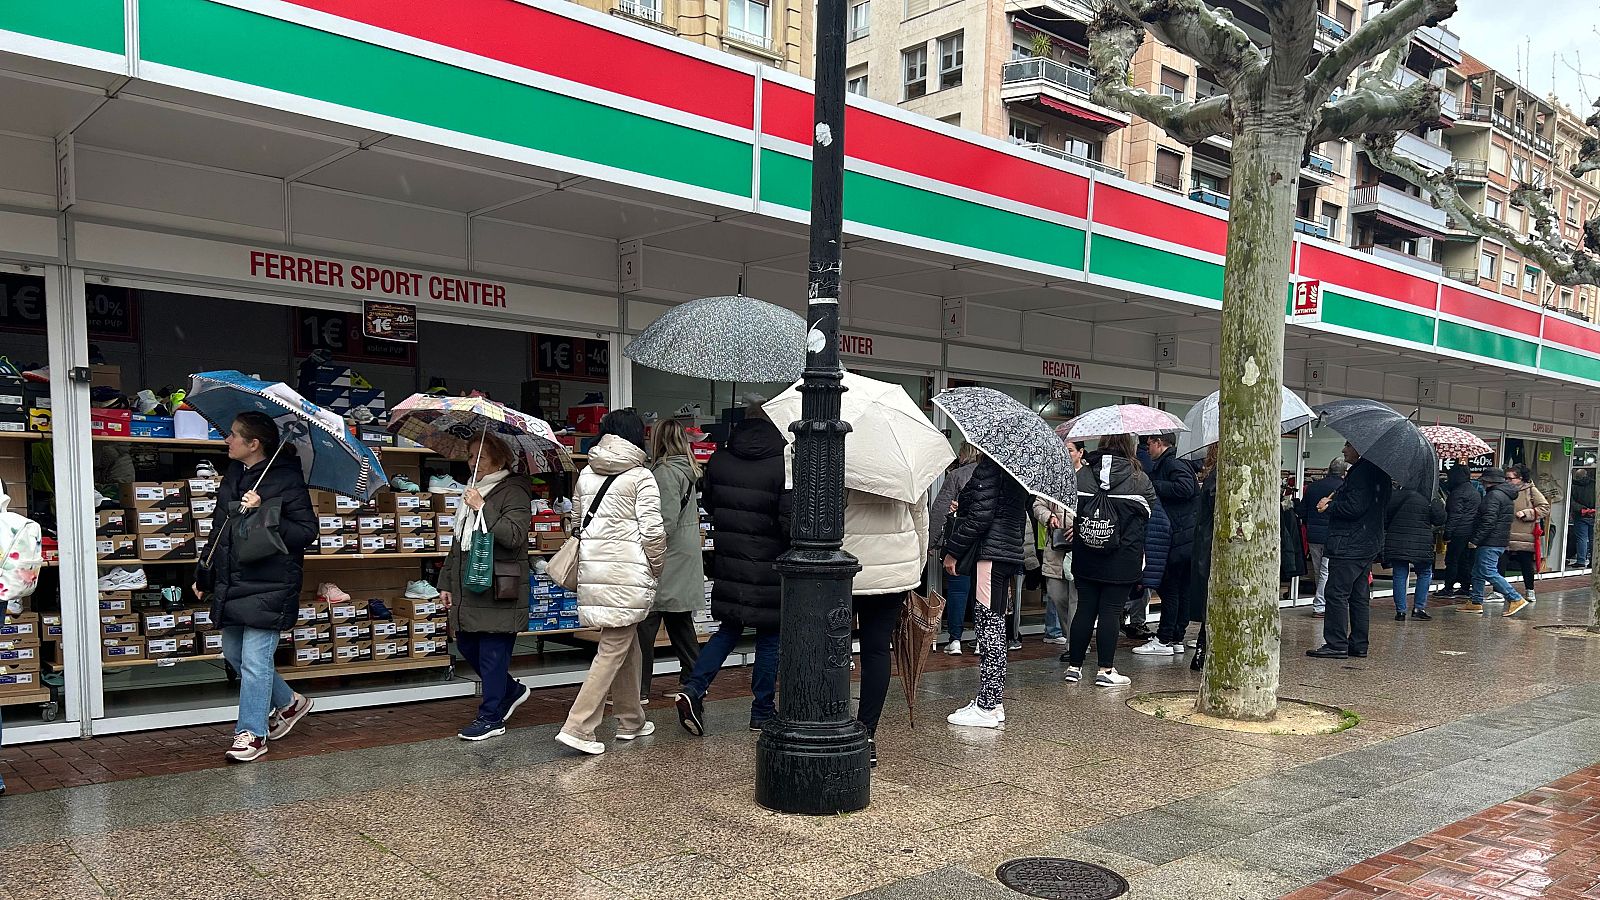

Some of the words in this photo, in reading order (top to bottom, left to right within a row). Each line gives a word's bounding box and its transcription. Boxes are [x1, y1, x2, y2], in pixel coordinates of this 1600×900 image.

[626, 261, 632, 275] 3
[250, 251, 344, 287] FERRER
[351, 265, 422, 297] SPORT
[429, 276, 507, 308] CENTER
[372, 318, 392, 333] 1€
[950, 314, 956, 325] 4
[304, 316, 343, 348] 1€
[540, 342, 570, 369] 1€
[1163, 347, 1169, 357] 5
[1043, 361, 1081, 379] REGATTA
[1312, 371, 1318, 379] 6
[1424, 388, 1429, 396] 7
[1469, 456, 1493, 466] -40%
